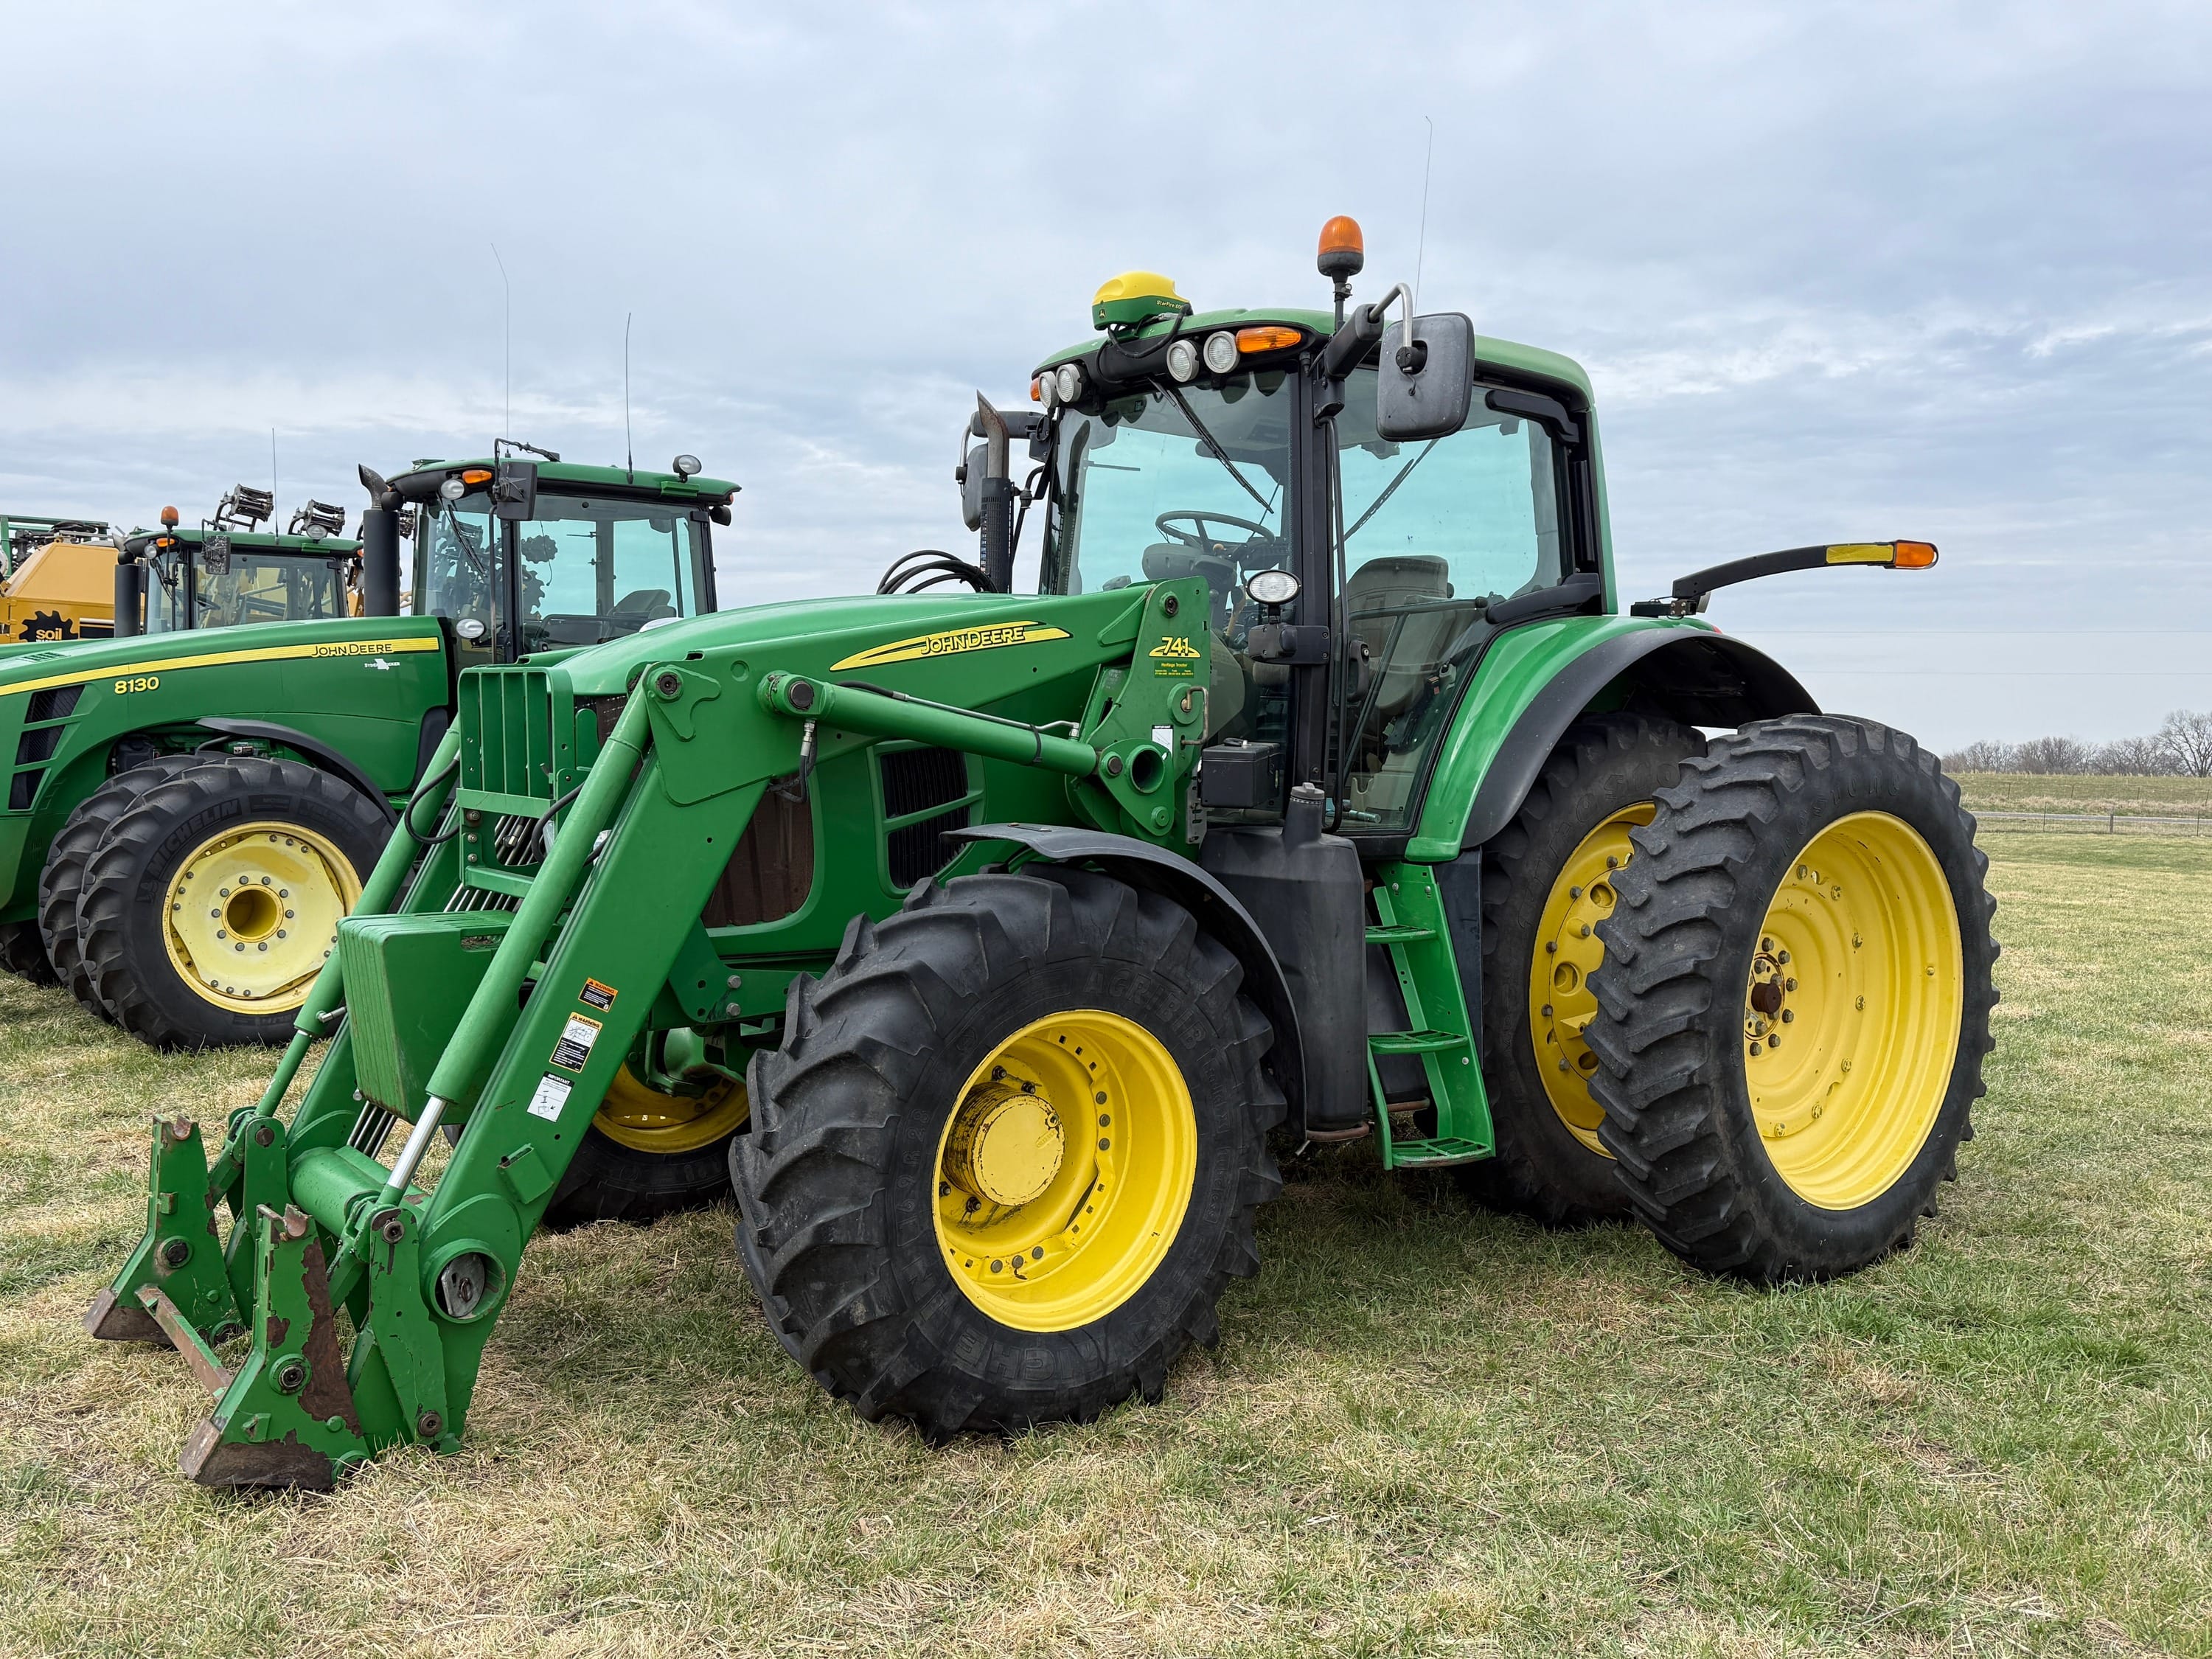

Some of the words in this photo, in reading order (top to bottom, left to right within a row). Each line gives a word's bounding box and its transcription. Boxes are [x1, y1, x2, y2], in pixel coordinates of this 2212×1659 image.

[35, 627, 63, 640] soil
[921, 636, 965, 655] JOHN
[967, 627, 1026, 647] DEERE
[311, 645, 347, 656] JOHN
[349, 643, 393, 655] DEERE
[1161, 636, 1189, 655] 741
[114, 676, 160, 695] 8130
[146, 798, 240, 880] MICHELIN
[578, 1017, 601, 1029] WARNING
